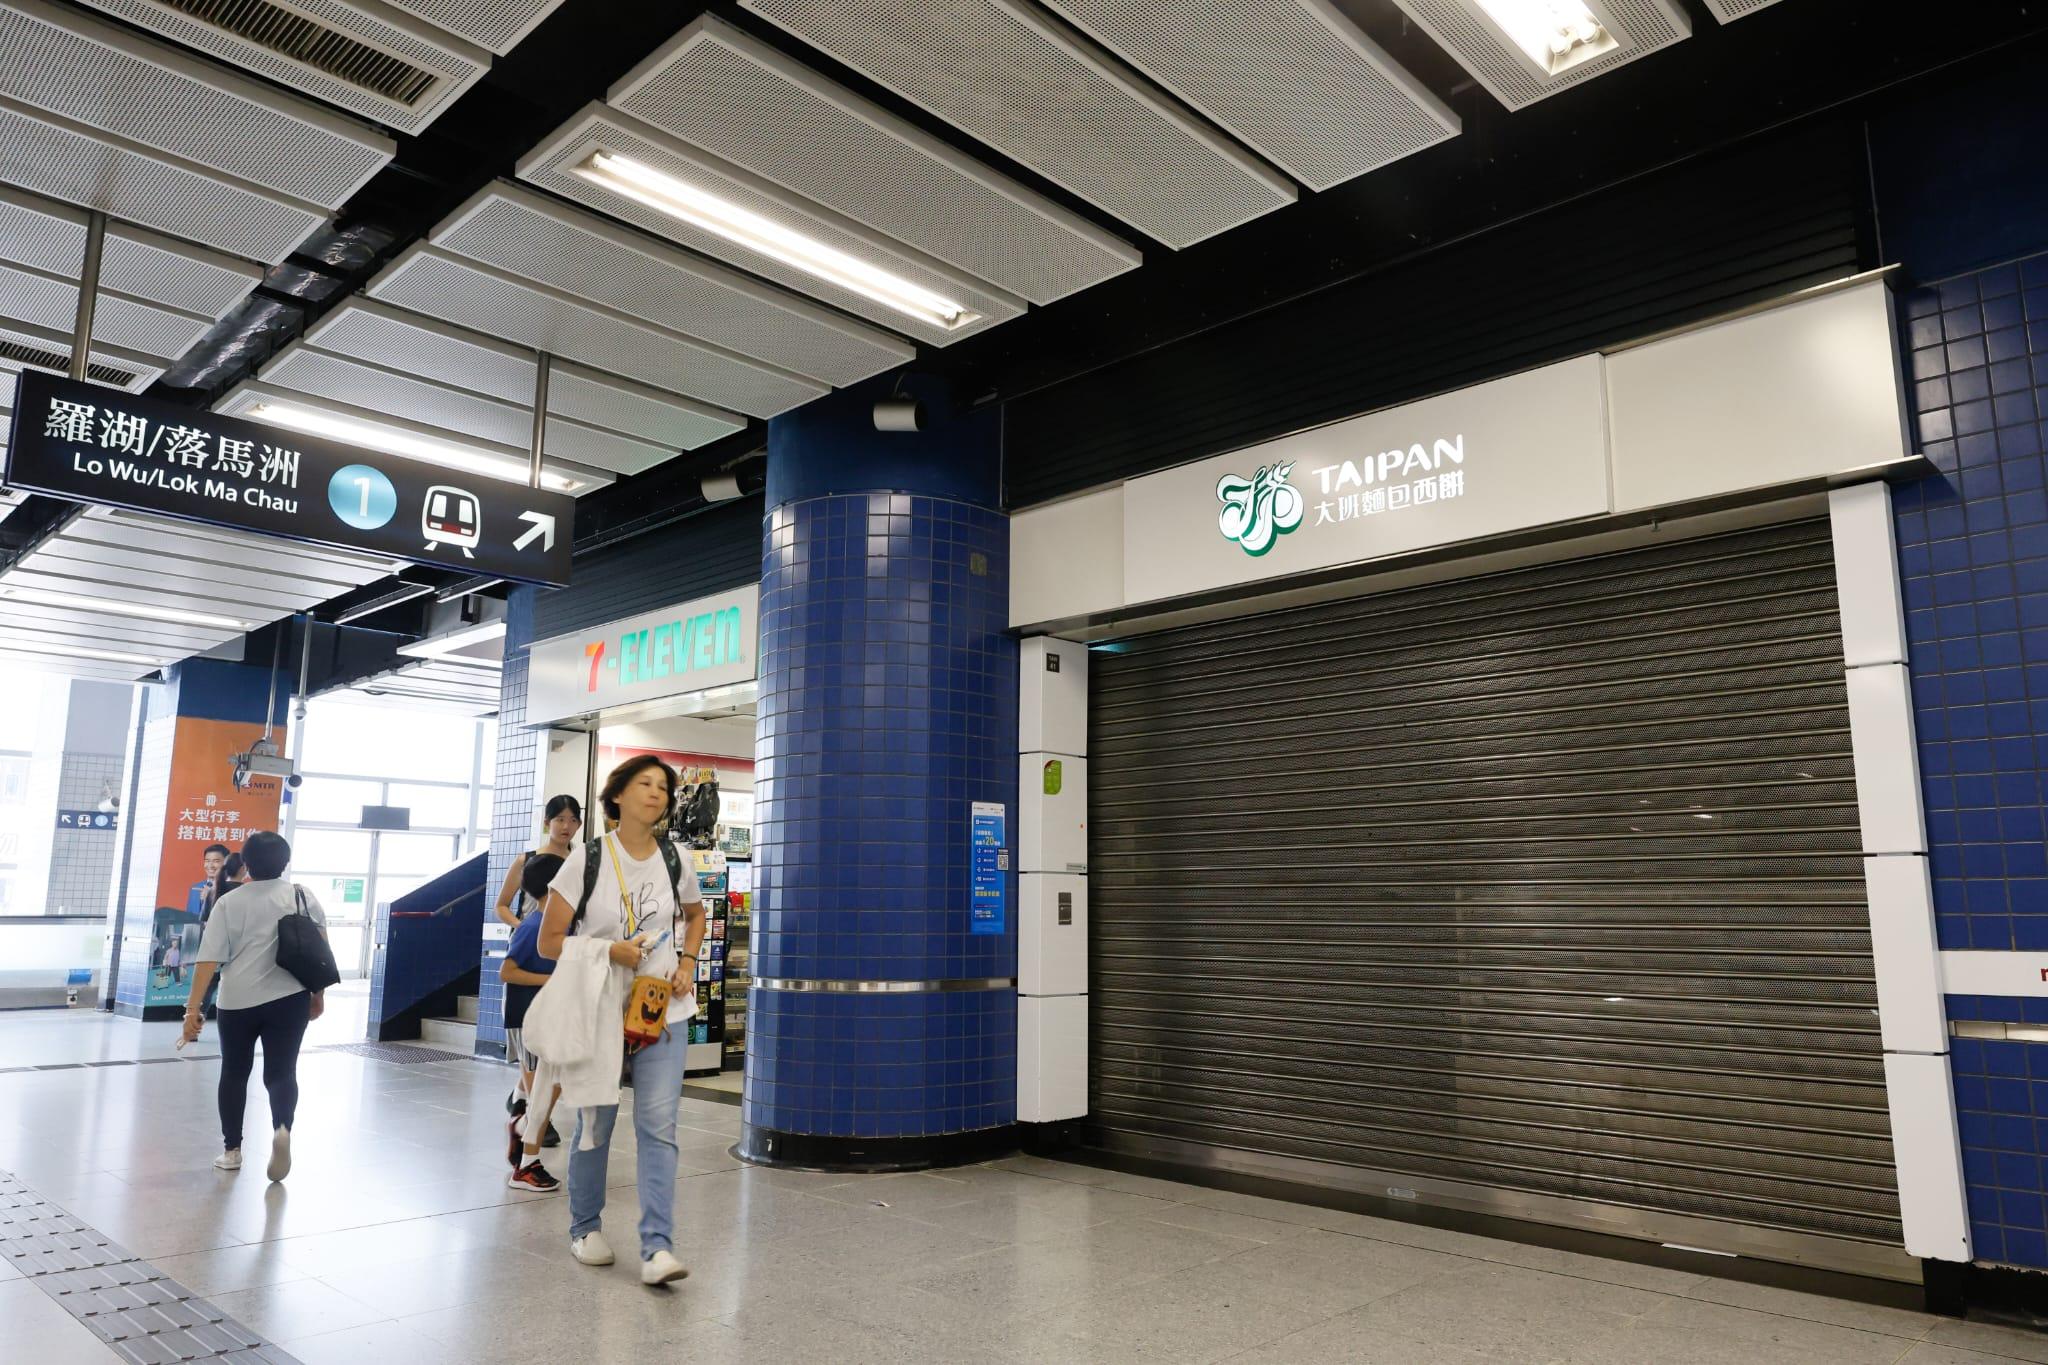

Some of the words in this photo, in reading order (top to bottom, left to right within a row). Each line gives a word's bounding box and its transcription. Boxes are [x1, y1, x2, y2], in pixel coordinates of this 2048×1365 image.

[44, 397, 301, 489] 羅湖/落馬洲
[1311, 434, 1464, 494] TAIPAN
[73, 452, 103, 476] Lo
[108, 458, 199, 495] Wu/Lok
[203, 478, 238, 502] Ma
[243, 488, 299, 514] Chau
[353, 477, 369, 518] 1
[1313, 469, 1465, 527] 大班麵包西餅
[179, 808, 241, 824] 大型行李
